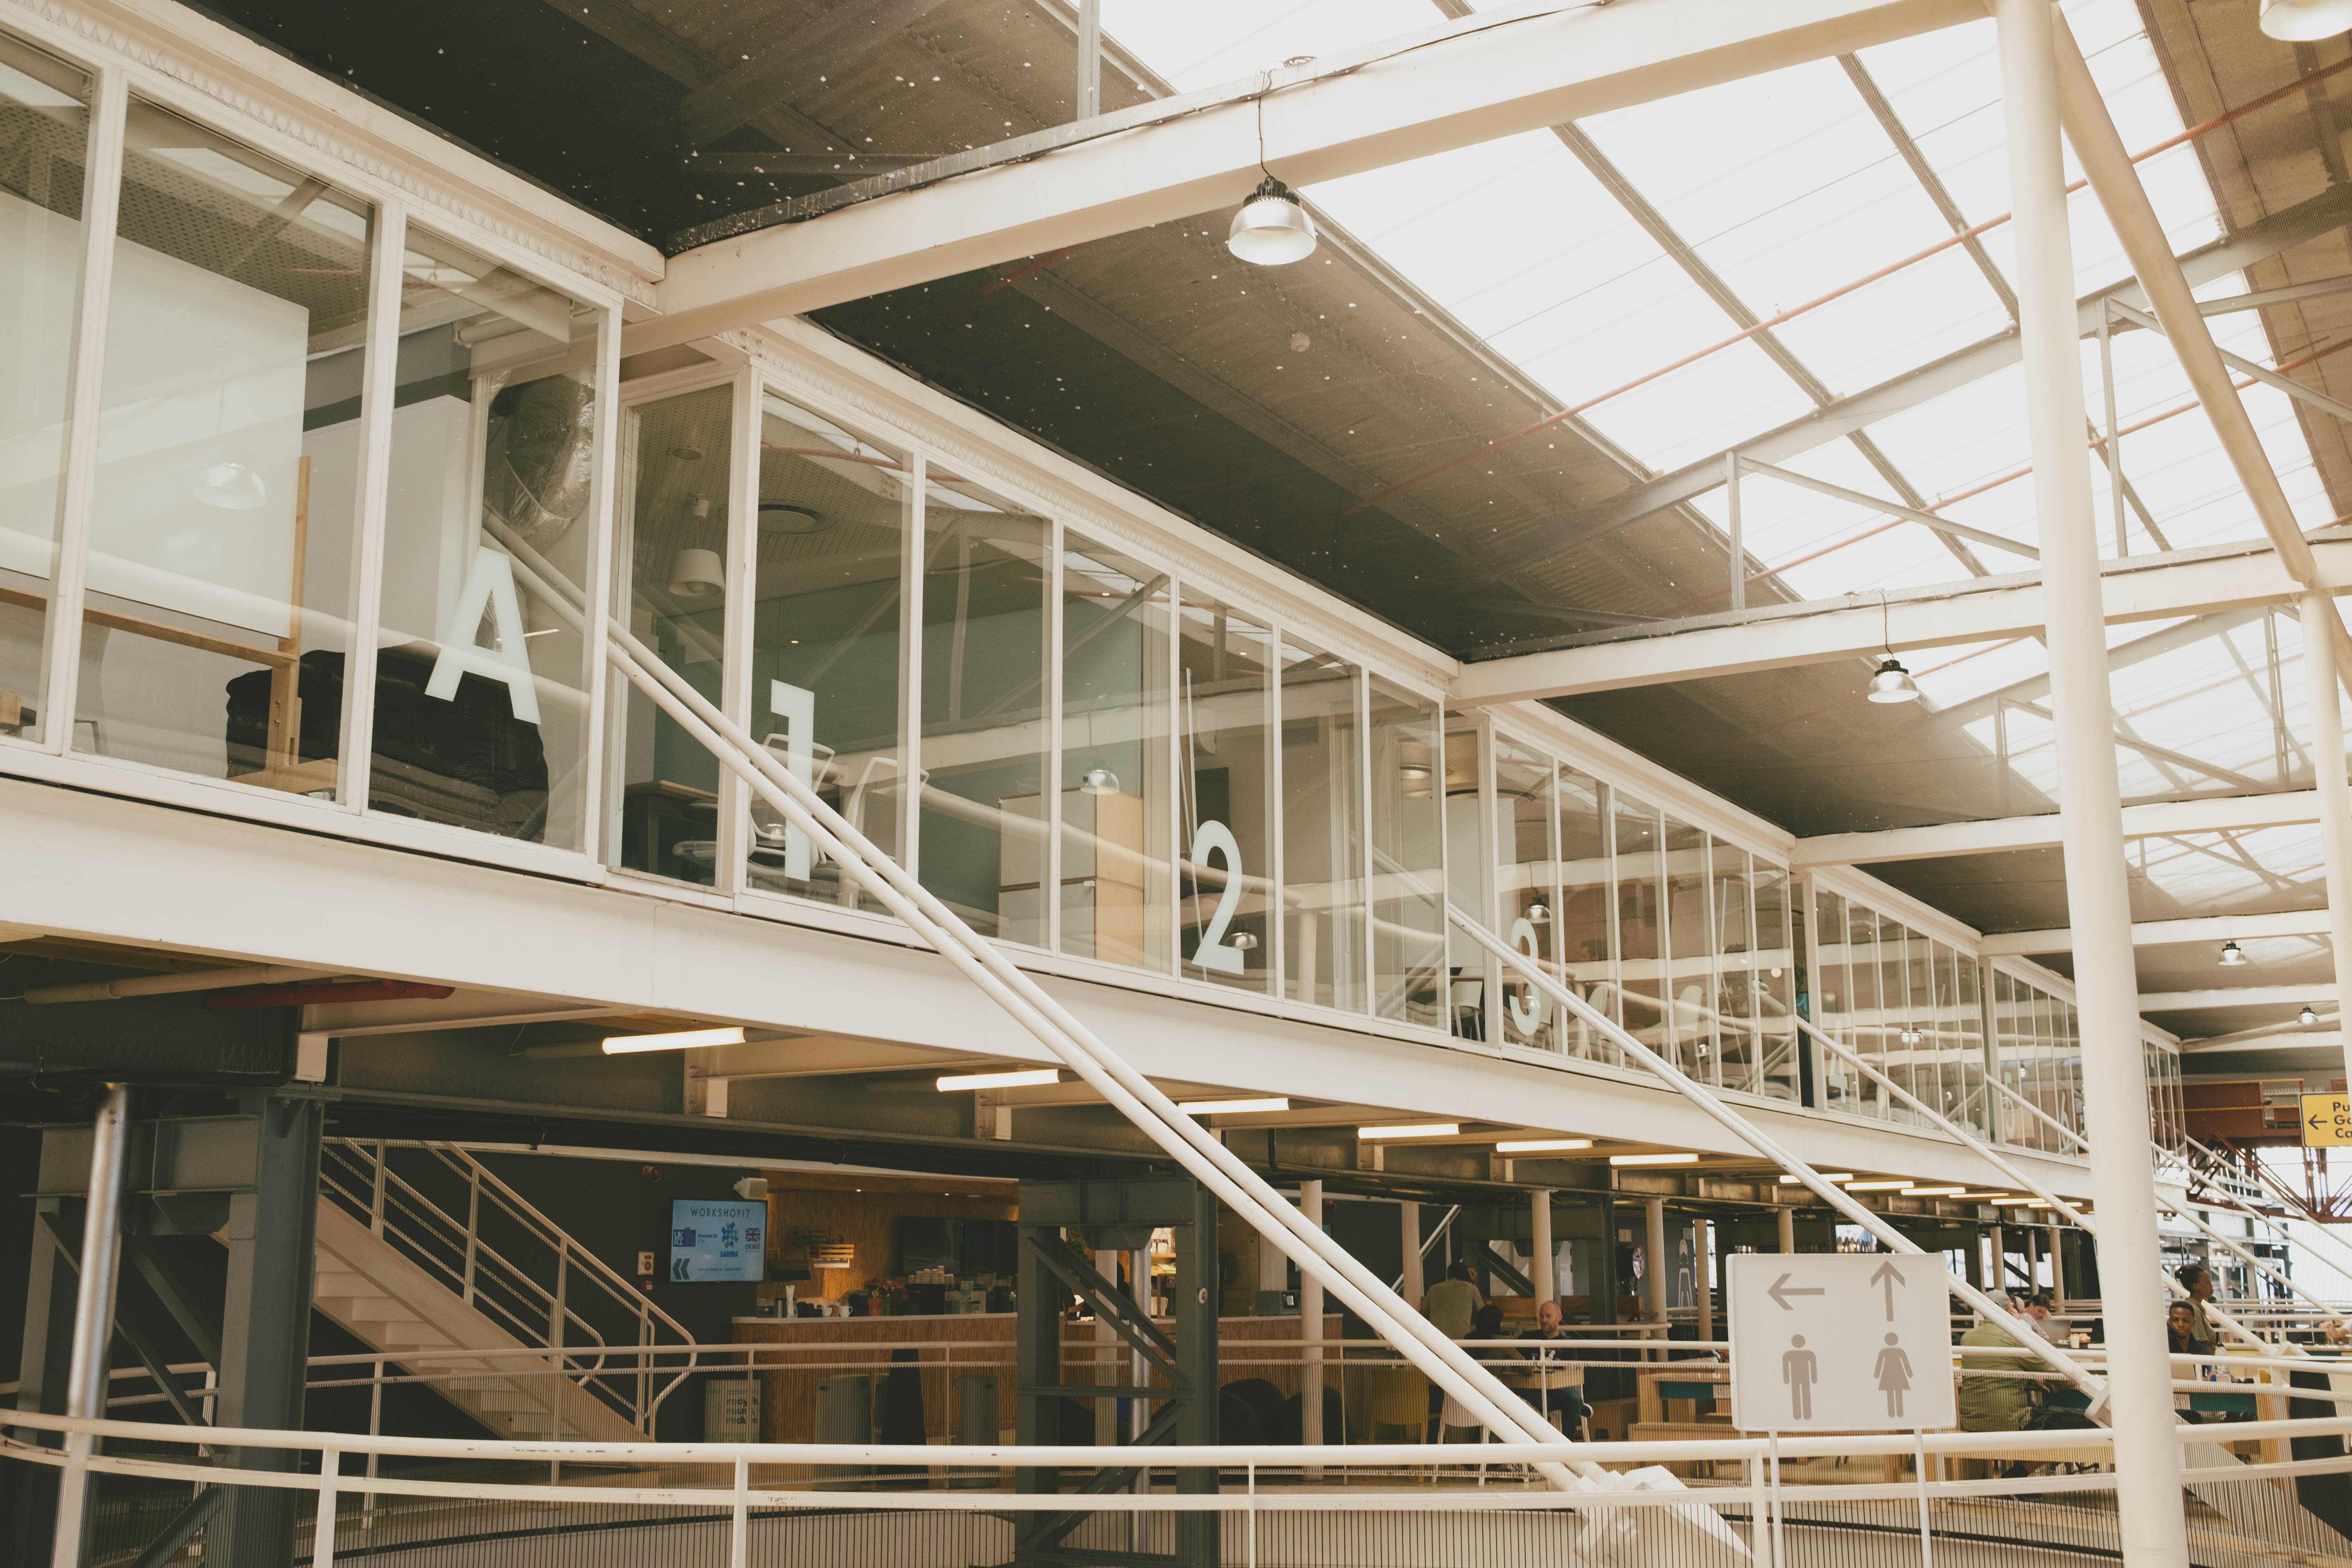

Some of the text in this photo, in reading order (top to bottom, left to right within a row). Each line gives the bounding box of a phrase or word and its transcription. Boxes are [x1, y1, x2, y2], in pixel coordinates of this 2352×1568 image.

[424, 546, 541, 725] A
[770, 679, 814, 882] 1
[1191, 820, 1245, 975] 2
[1509, 918, 1541, 1035] 3
[1828, 1018, 1848, 1102] 4
[2333, 1102, 2350, 1112] Pu
[690, 1207, 751, 1218] WORKSHOP17
